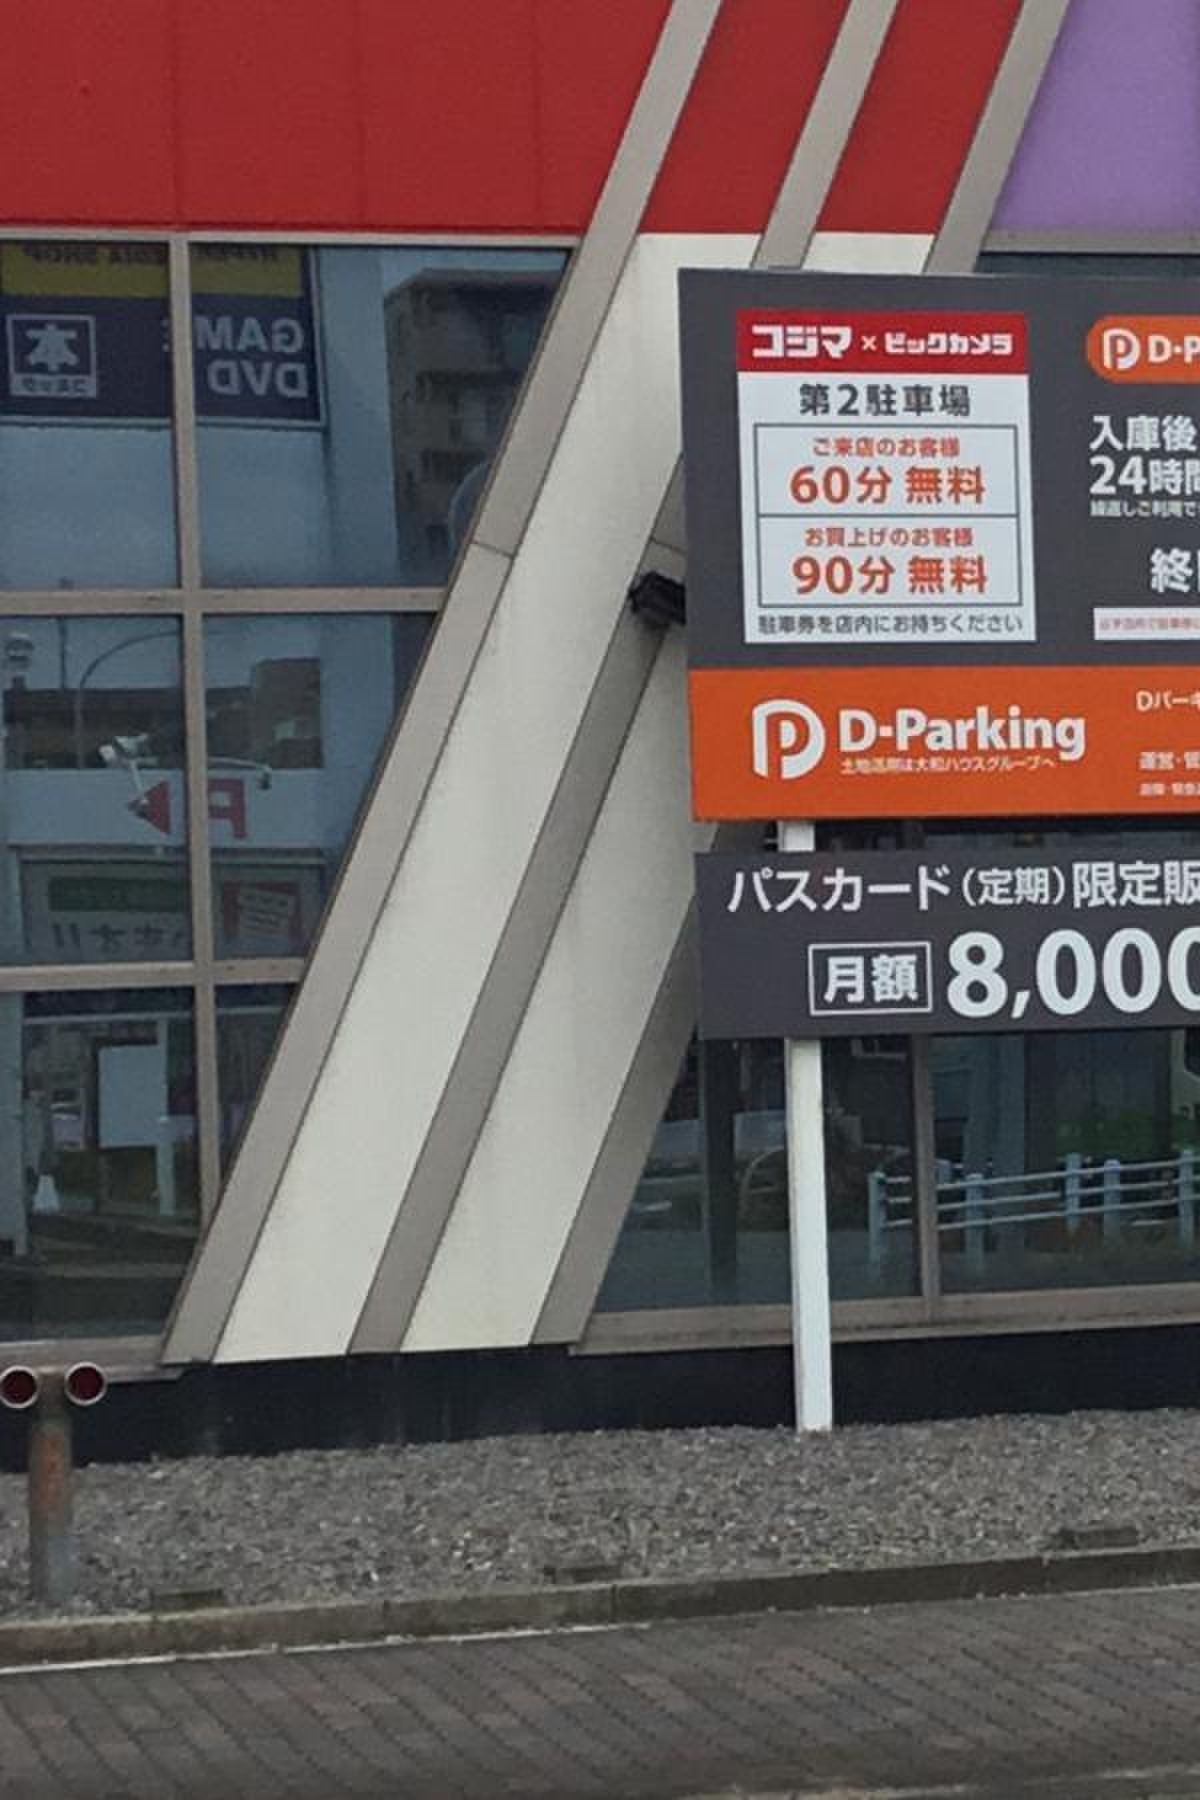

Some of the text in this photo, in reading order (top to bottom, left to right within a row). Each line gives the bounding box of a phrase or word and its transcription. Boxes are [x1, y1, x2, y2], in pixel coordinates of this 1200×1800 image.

[752, 324, 853, 359] コジマ
[799, 383, 970, 417] 第2駐車場
[1088, 415, 1198, 452] 入庫後
[789, 465, 985, 504] 60分 無料
[791, 555, 988, 595] 90分 無料
[823, 954, 919, 1003] 月額
